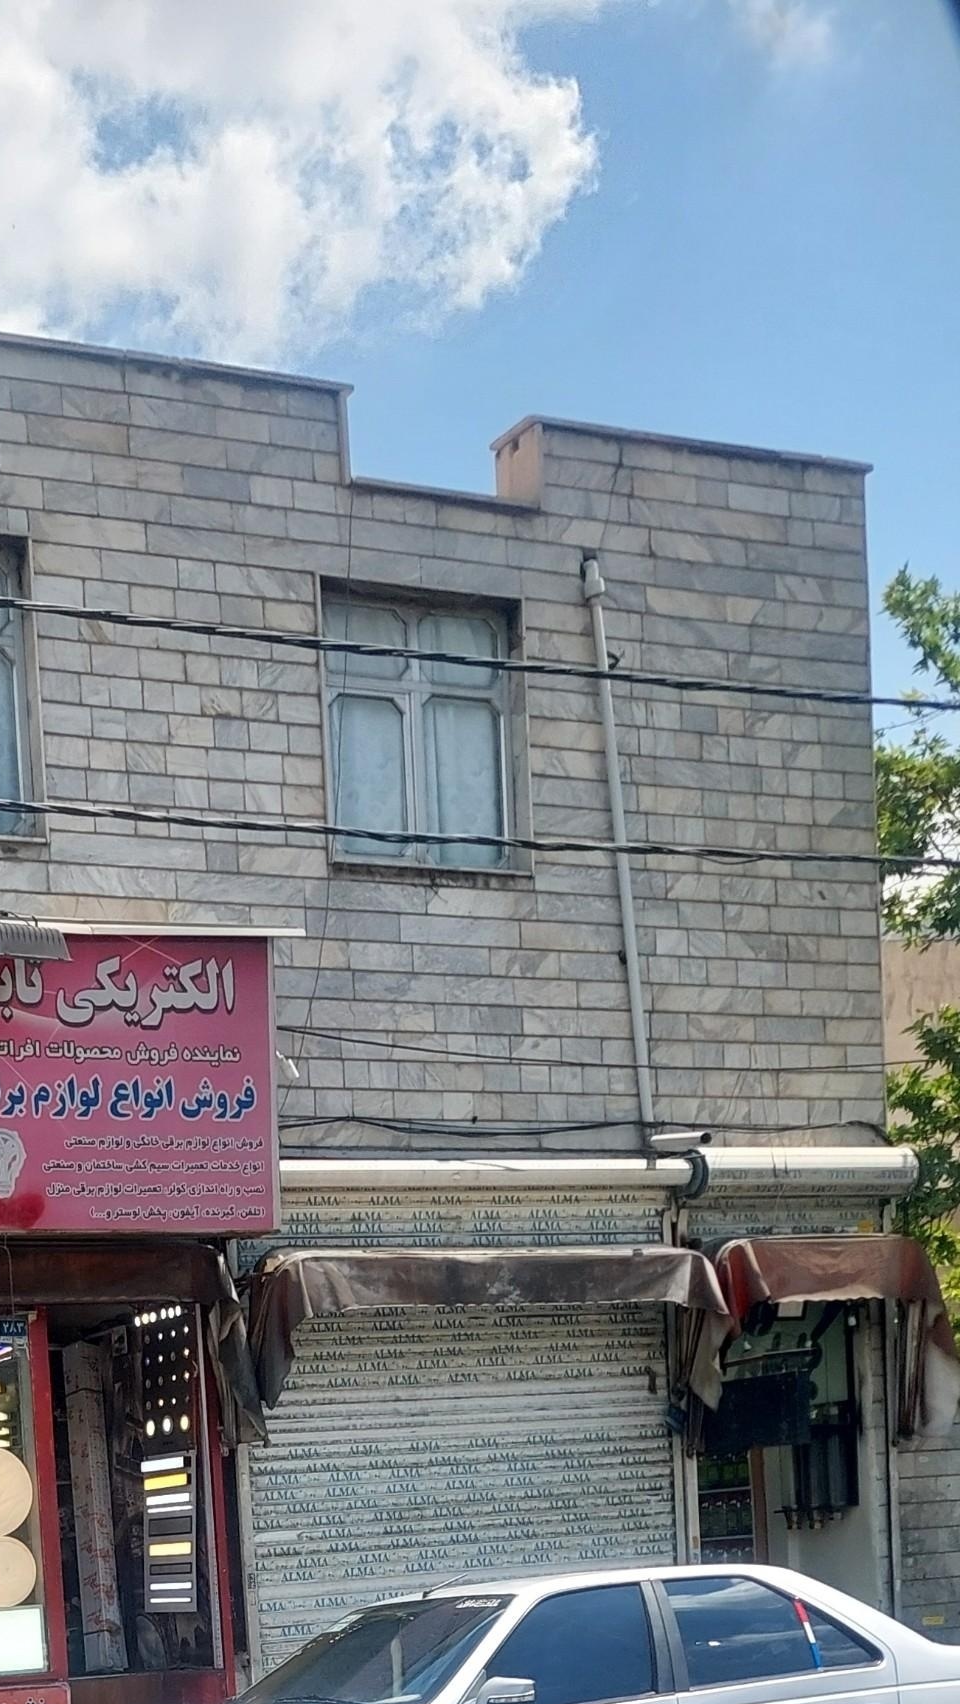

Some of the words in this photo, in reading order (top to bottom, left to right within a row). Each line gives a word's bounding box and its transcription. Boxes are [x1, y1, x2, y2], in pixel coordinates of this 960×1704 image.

[55, 955, 236, 1028] الکتریکی
[45, 1040, 121, 1061] محصولات
[126, 1042, 178, 1066] فروش
[182, 1043, 241, 1066] نماینده
[32, 1073, 102, 1120] لوازم
[109, 1074, 175, 1120] انواع
[179, 1075, 257, 1121] فروش
[64, 1135, 96, 1149] صنعتی
[98, 1135, 123, 1149] لوازم
[133, 1135, 160, 1149] خانگی
[161, 1136, 184, 1150] برقی
[185, 1135, 210, 1150] لوازم
[211, 1136, 234, 1152] انواع
[236, 1136, 264, 1151] فروش
[43, 1159, 75, 1173] صنعتی
[84, 1160, 123, 1173] ساختمان
[125, 1159, 148, 1172] کشی
[149, 1161, 169, 1173] سیم
[171, 1160, 209, 1173] تعمیرات
[210, 1160, 240, 1171] خدمات
[242, 1161, 265, 1176] انواع
[46, 1183, 71, 1196] منزل
[72, 1183, 95, 1196] برقی
[97, 1183, 122, 1196] لوازم
[124, 1183, 162, 1196] تعمیرات
[188, 1183, 218, 1196] اندازی
[218, 1184, 234, 1196] راه
[243, 1185, 265, 1196] نصب
[305, 1196, 339, 1206] ALMA
[430, 1196, 462, 1205] ALMA
[549, 1195, 580, 1204] ALMA
[606, 1194, 638, 1203] ALMA
[114, 1206, 141, 1218] لوستر
[143, 1208, 167, 1221] پخش
[350, 1211, 382, 1221] ALMA
[471, 1210, 501, 1219] ALMA
[585, 1208, 615, 1217] ALMA
[350, 1223, 382, 1233] ALMA
[412, 1223, 443, 1232] ALMA
[472, 1222, 503, 1232] ALMA
[530, 1221, 561, 1231] ALMA
[3, 1321, 24, 1334] ۲۸۳
[371, 1322, 404, 1330] ALMA
[294, 1364, 327, 1374] ALMA
[415, 1360, 448, 1369] ALMA
[447, 1373, 479, 1382] ALMA
[563, 1368, 594, 1377] ALMA
[387, 1376, 420, 1385] ALMA
[328, 1471, 361, 1482] ALMA
[389, 1468, 421, 1478] ALMA
[266, 1475, 300, 1485] ALMA
[503, 1477, 534, 1487] ALMA
[262, 1491, 295, 1501] ALMA
[324, 1487, 357, 1497] ALMA
[357, 1553, 390, 1563] ALMA
[463, 1558, 494, 1568] ALMA
[520, 1555, 551, 1564] ALMA
[403, 1563, 435, 1573] ALMA
[281, 1571, 314, 1582] ALMA
[314, 1598, 347, 1608] ALMA
